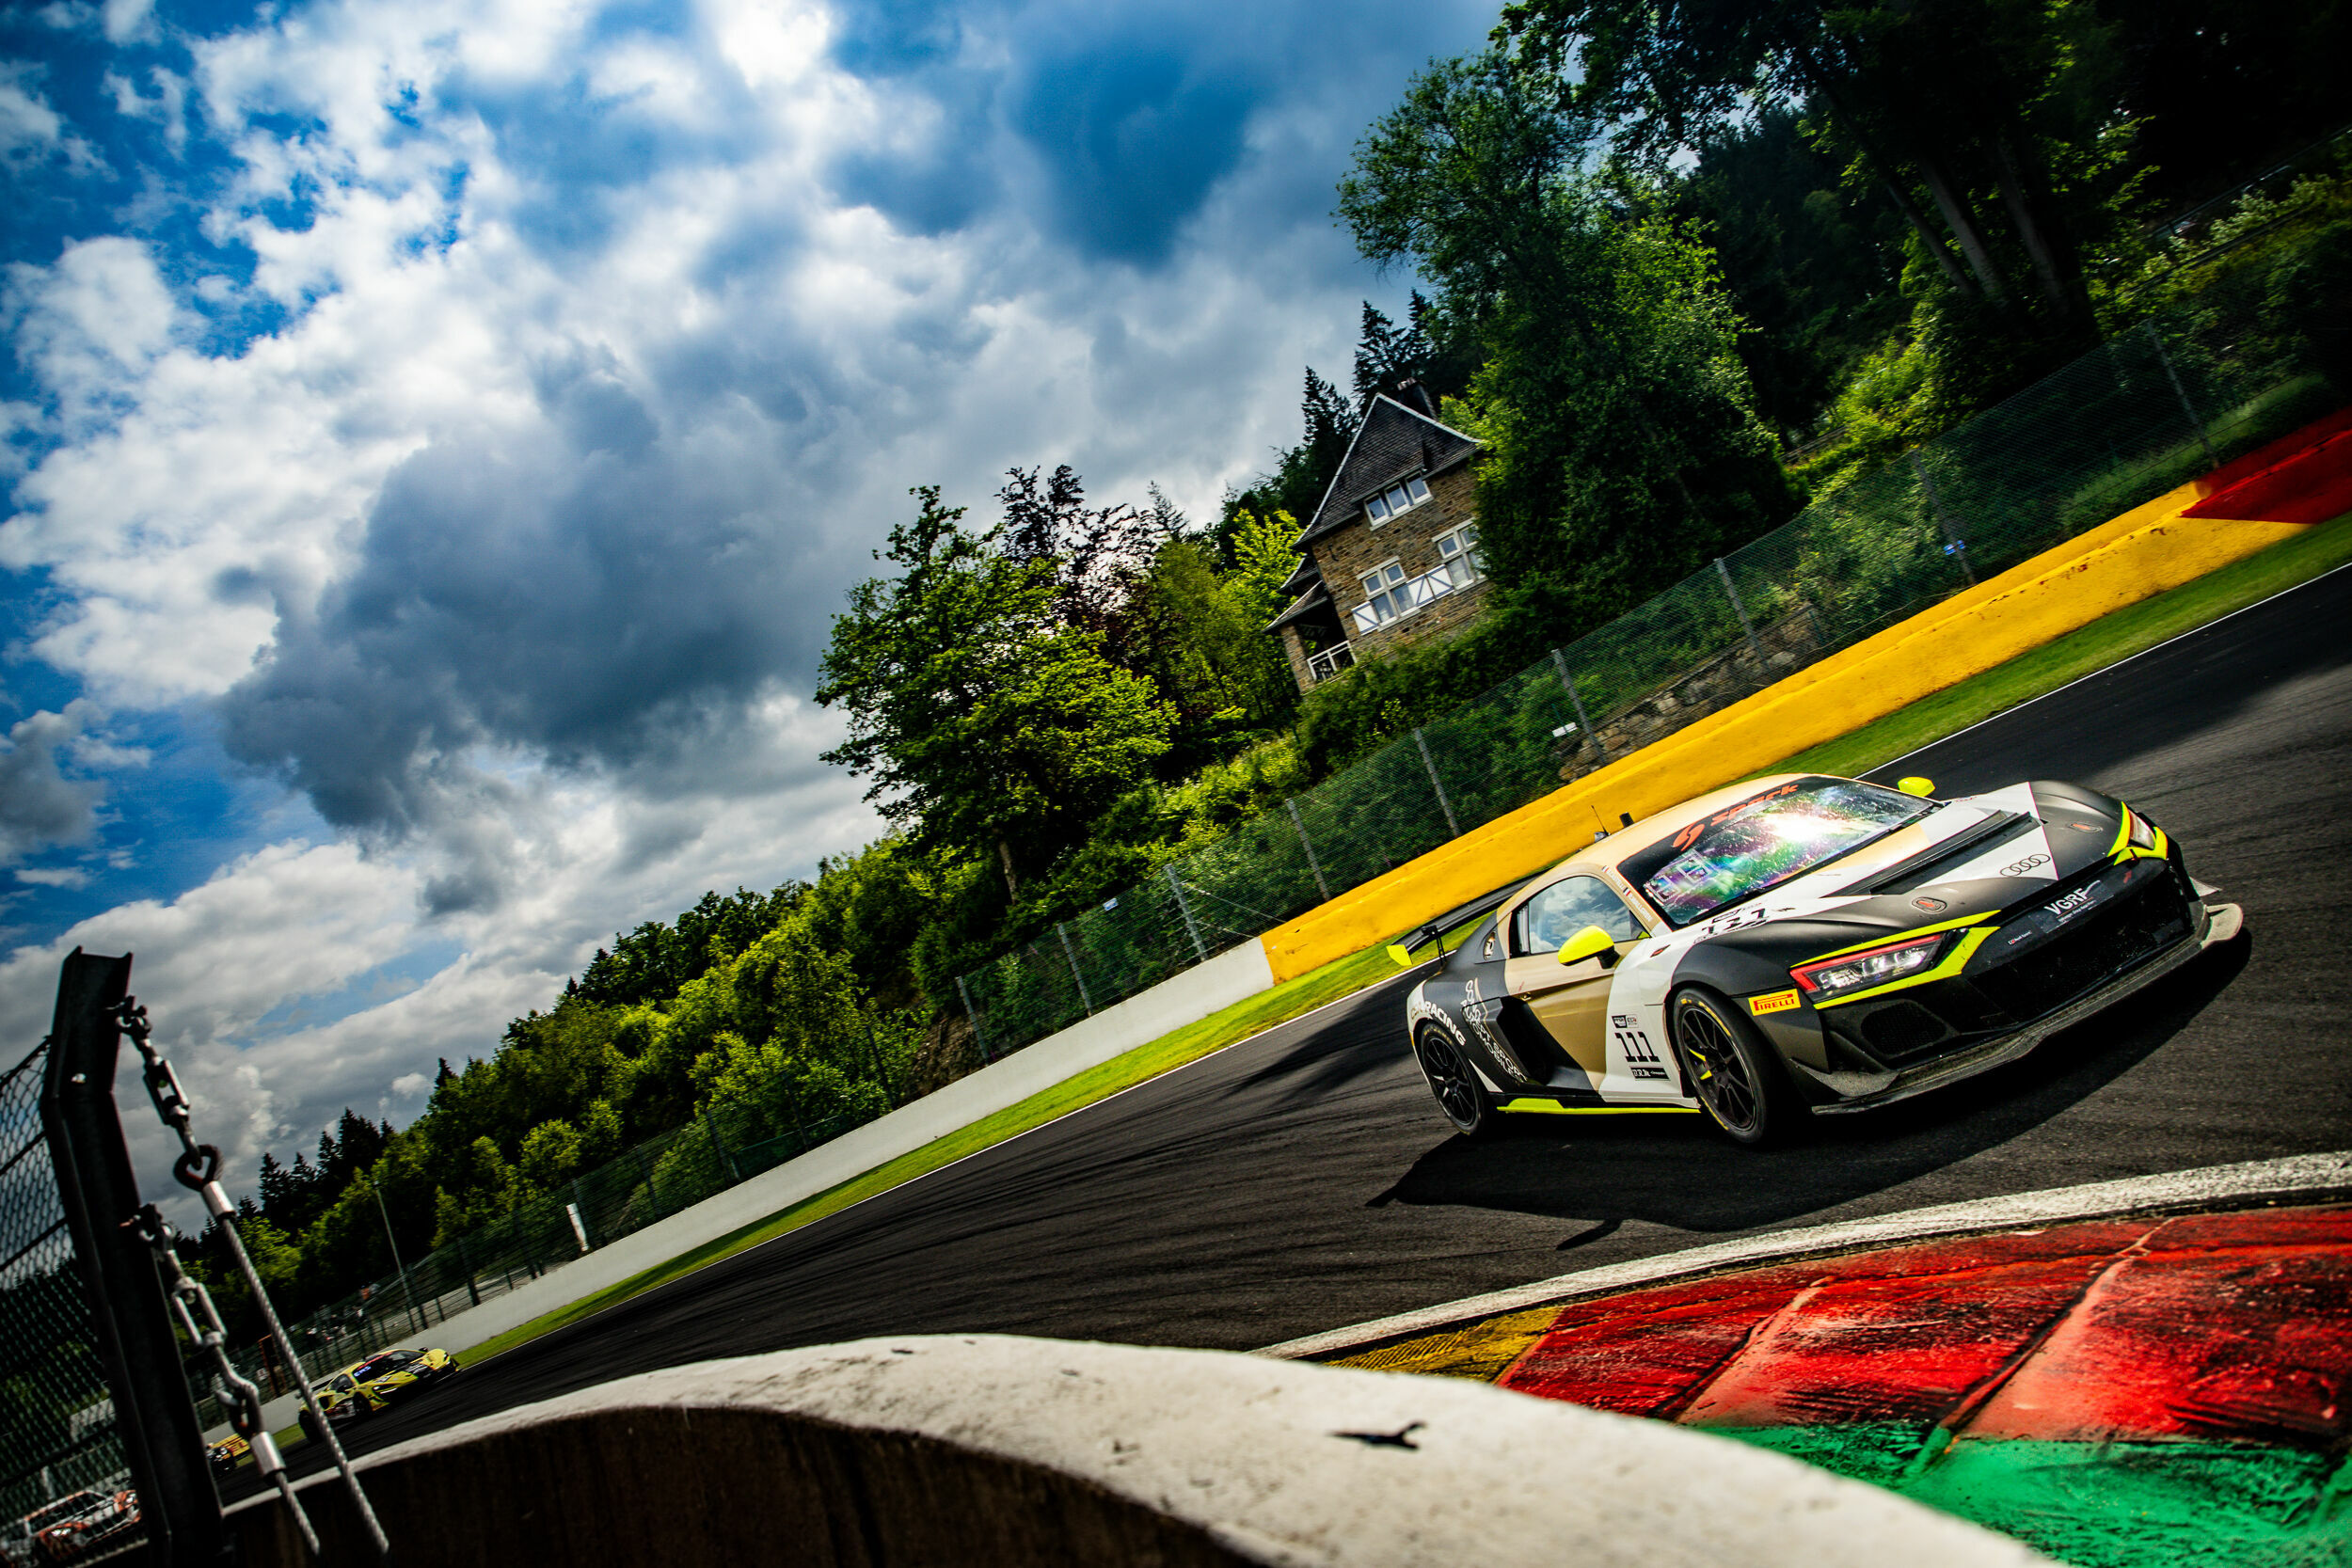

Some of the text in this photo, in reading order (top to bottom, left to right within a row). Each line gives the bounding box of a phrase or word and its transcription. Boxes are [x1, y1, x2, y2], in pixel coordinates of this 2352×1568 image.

[2043, 881, 2098, 915] VGRF
[1753, 993, 1795, 1011] PIRELLI
[1424, 1000, 1467, 1046] RACING
[1492, 1041, 1528, 1082] SPORT
[1614, 1031, 1661, 1063] 111
